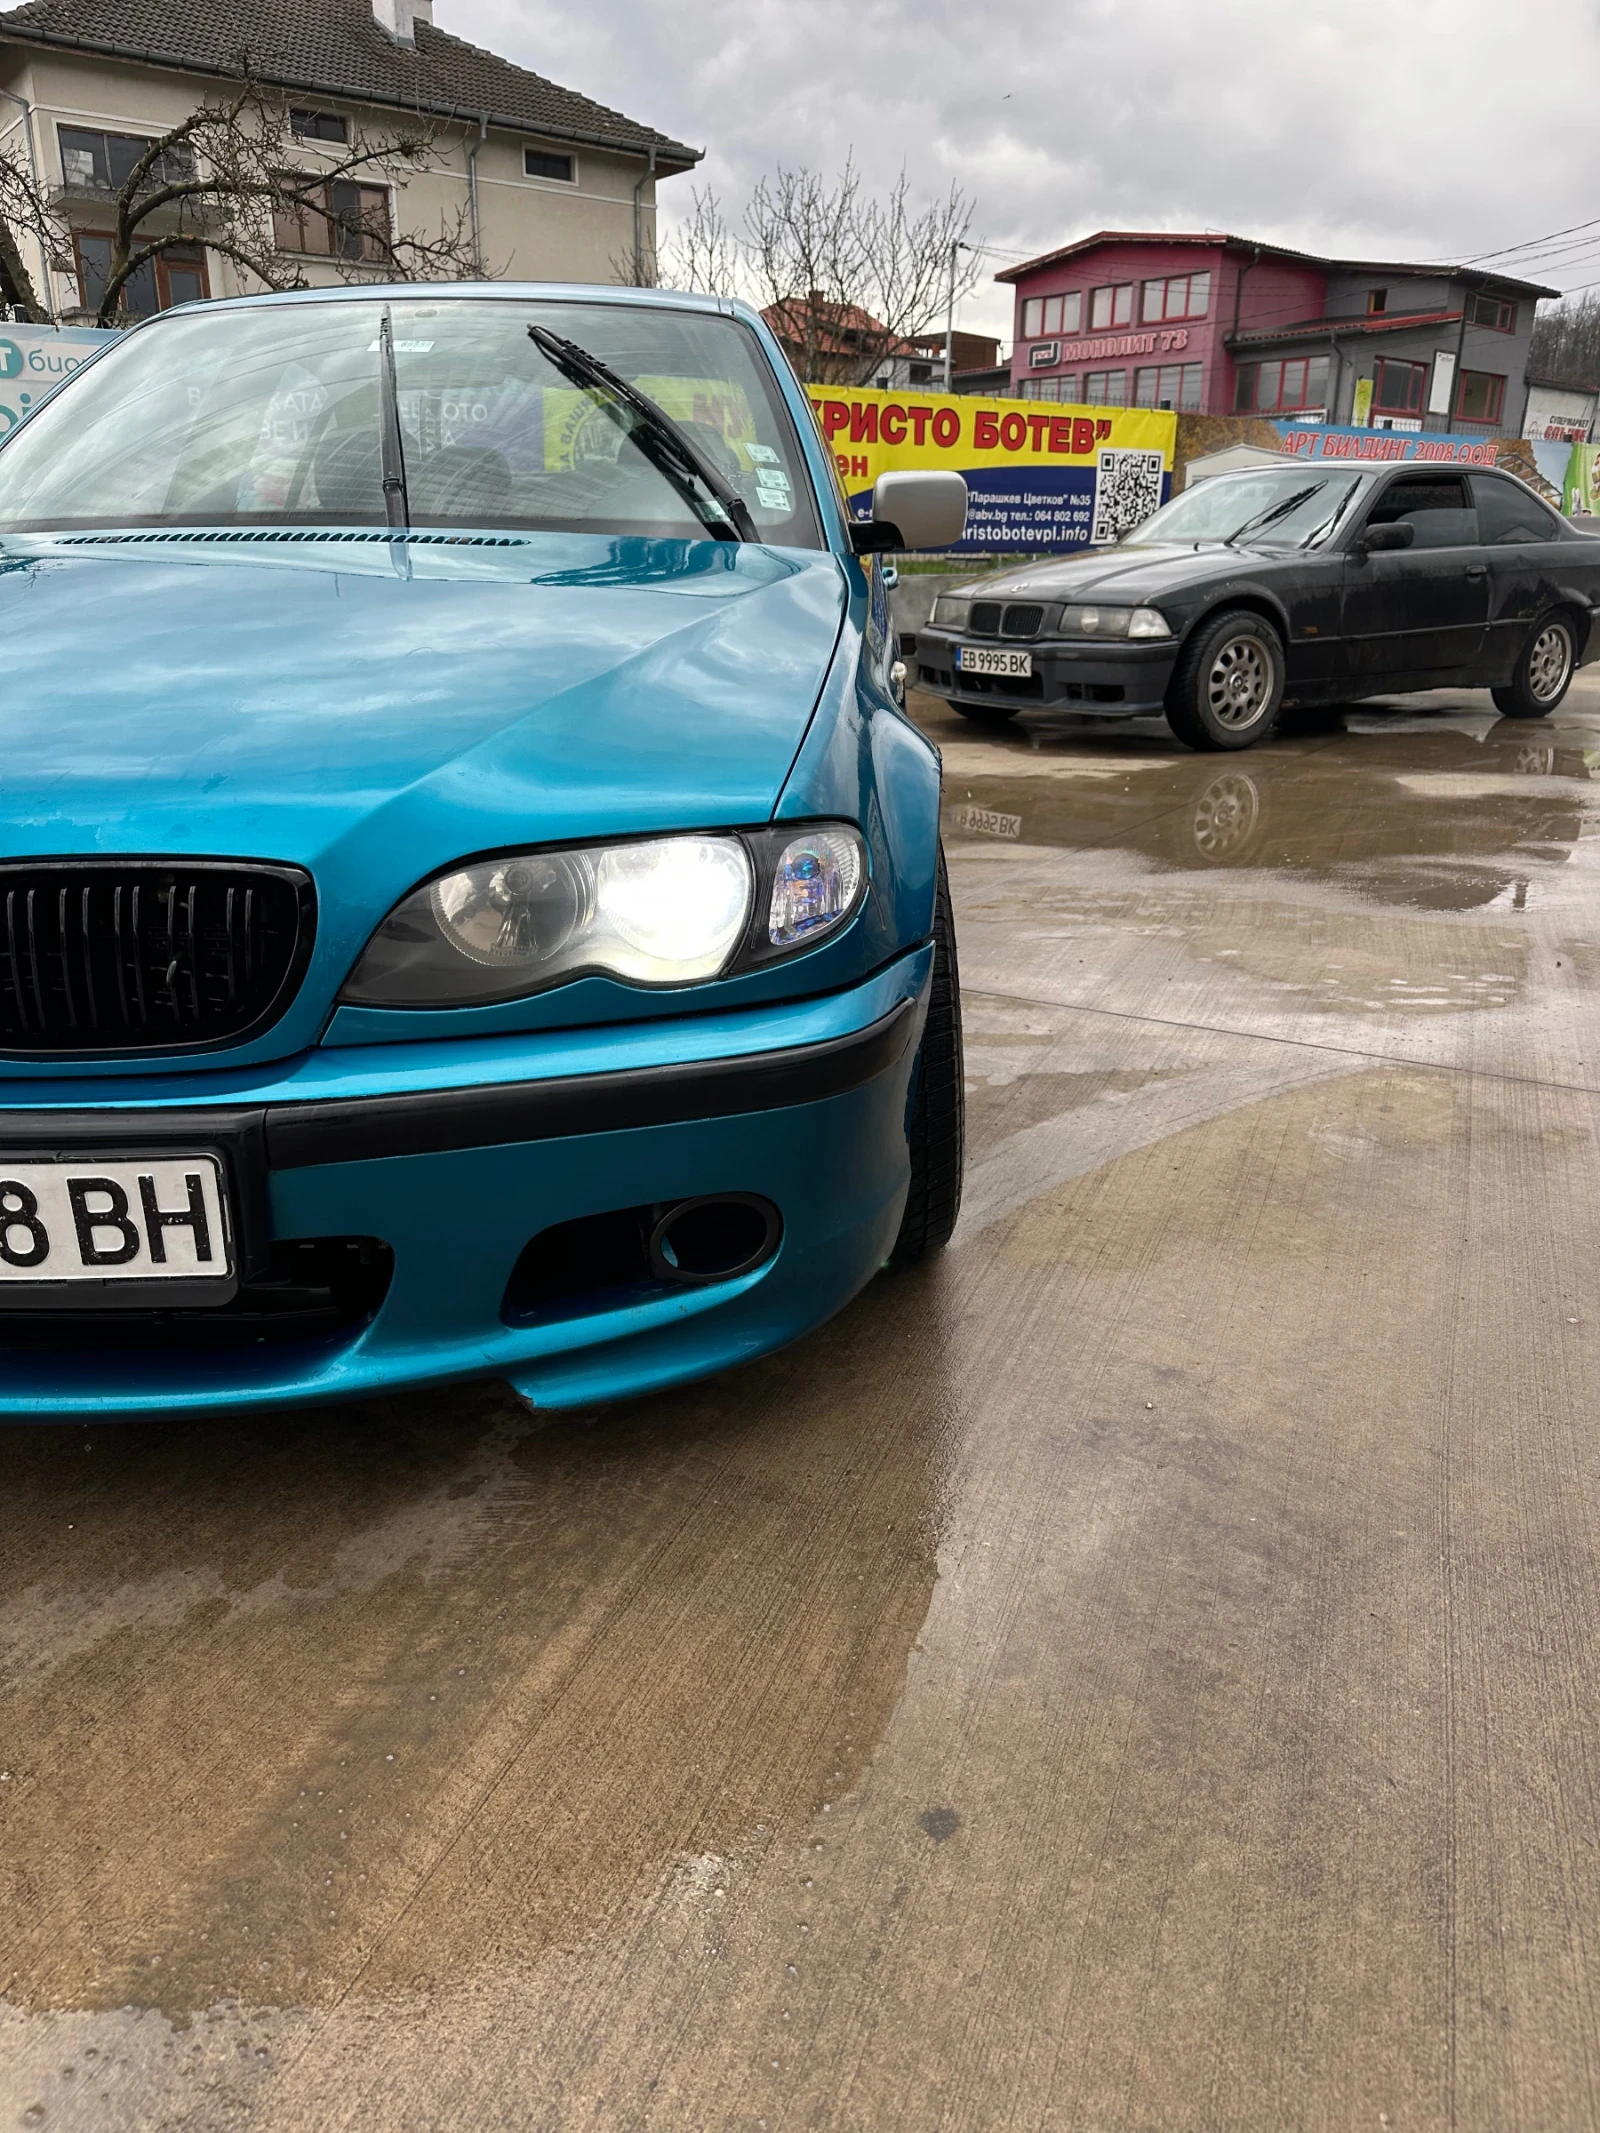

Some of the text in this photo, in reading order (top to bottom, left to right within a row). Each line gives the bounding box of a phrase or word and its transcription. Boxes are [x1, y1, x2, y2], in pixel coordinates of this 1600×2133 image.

[1062, 329, 1188, 362] МОНОЛИТ 73
[28, 349, 86, 373] био
[1279, 430, 1499, 466] АРТ БИЛДИНГ 2008 ООД
[1070, 495, 1091, 506] №35
[1034, 510, 1052, 522] 064
[1053, 511, 1071, 522] 802
[1073, 512, 1090, 523] 692
[962, 650, 1029, 673] EB 9995 BK
[66, 1173, 212, 1266] BH
